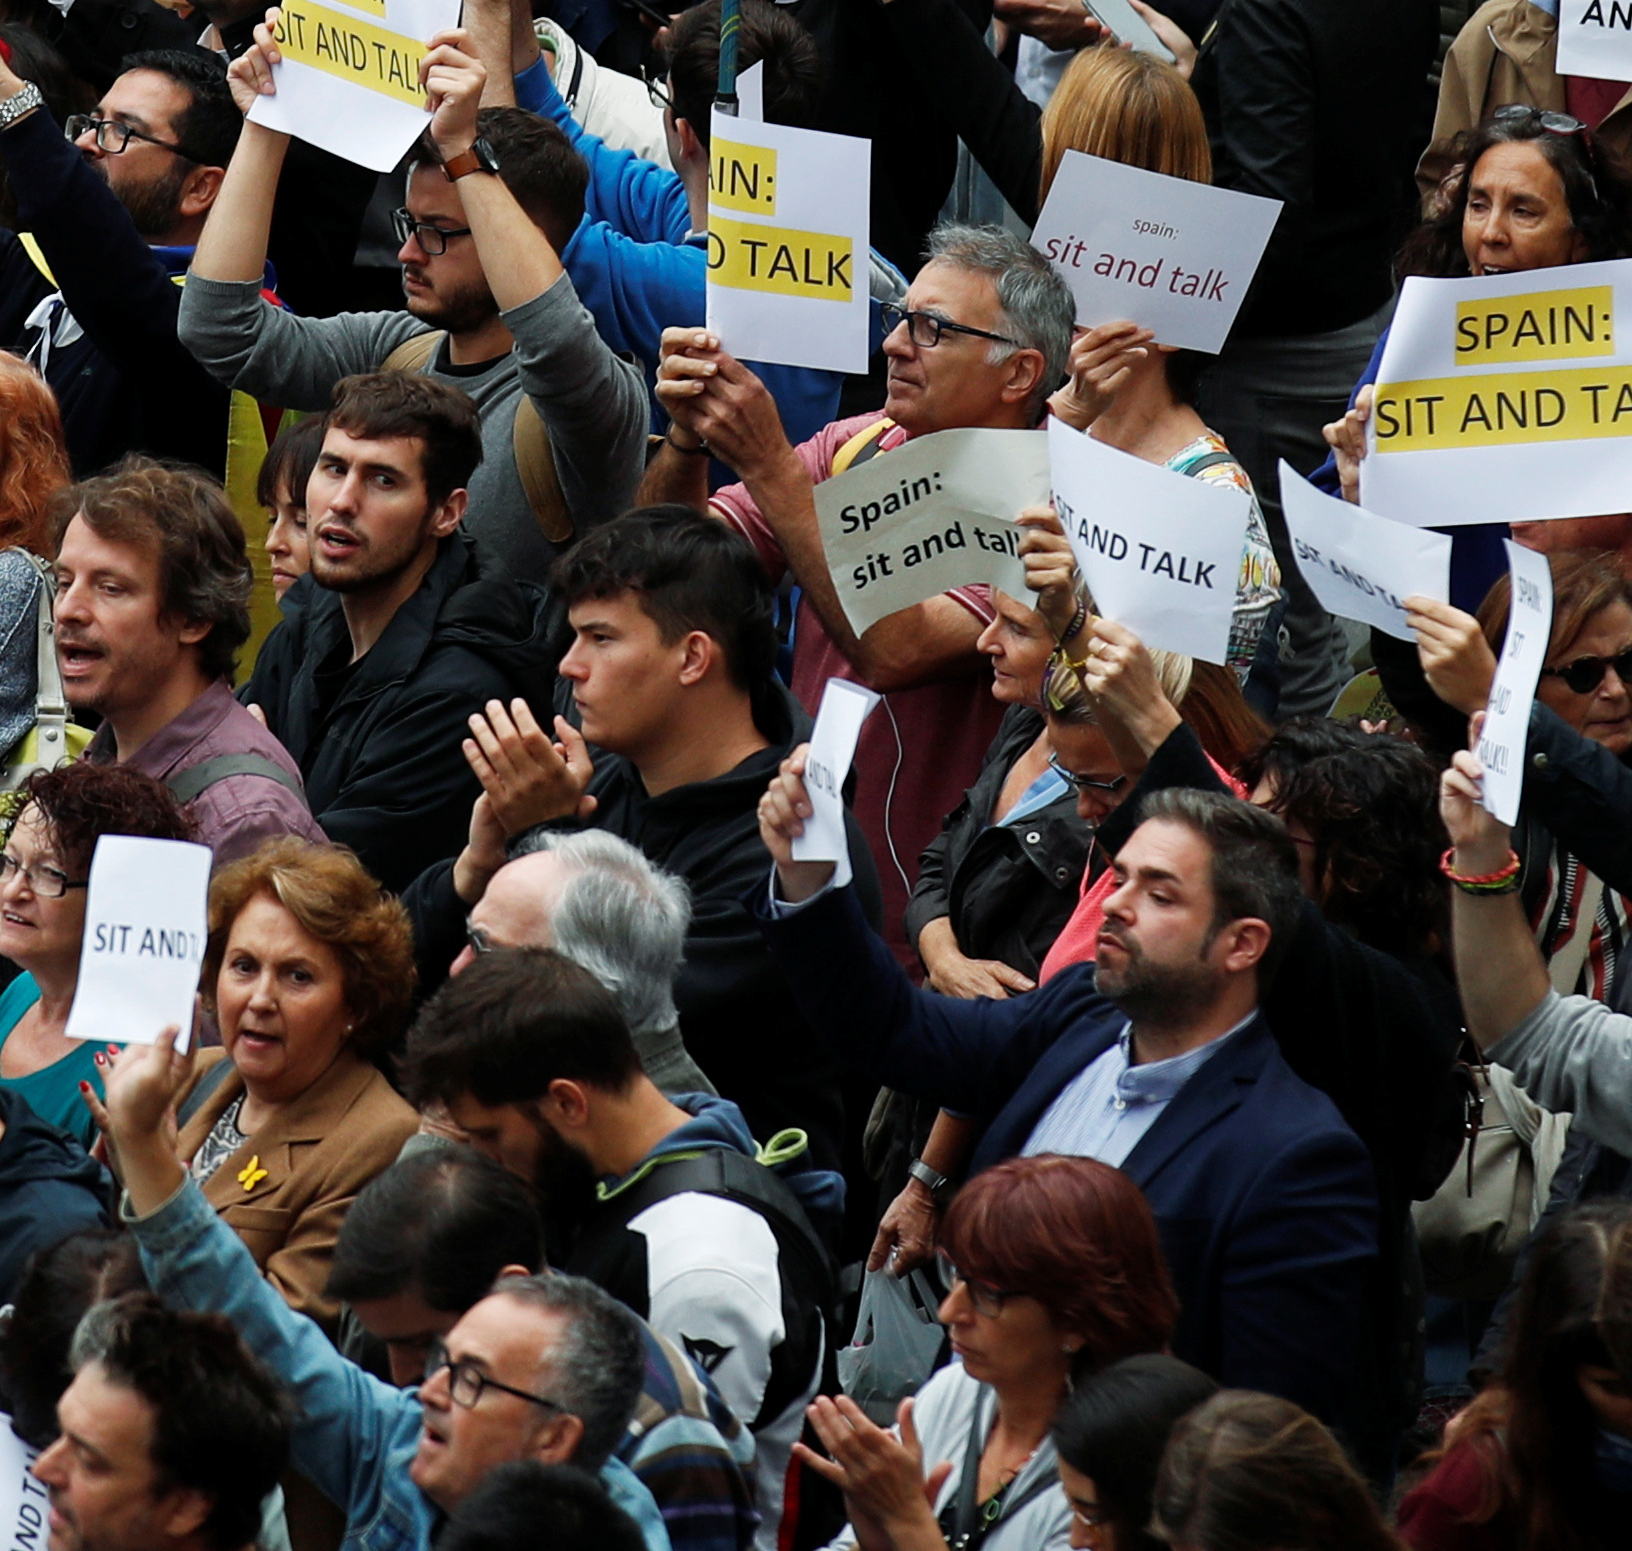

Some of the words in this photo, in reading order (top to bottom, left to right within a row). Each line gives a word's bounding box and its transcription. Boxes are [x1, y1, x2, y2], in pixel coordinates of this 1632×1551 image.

[273, 6, 308, 55] SIT
[316, 22, 368, 73] AND
[1132, 216, 1179, 241] spain:
[740, 239, 852, 289] TALK
[1047, 234, 1087, 268] sit
[1094, 248, 1162, 289] and
[1168, 264, 1230, 303] talk
[1456, 306, 1613, 354] SPAIN:
[1375, 394, 1447, 440] SIT
[1459, 387, 1567, 434] AND
[839, 470, 943, 534] Spain:
[853, 550, 894, 589] sit
[902, 521, 966, 569] and
[1078, 519, 1128, 560] AND
[1137, 542, 1218, 588] TALK
[94, 922, 132, 957] SIT
[138, 927, 186, 962] AND
